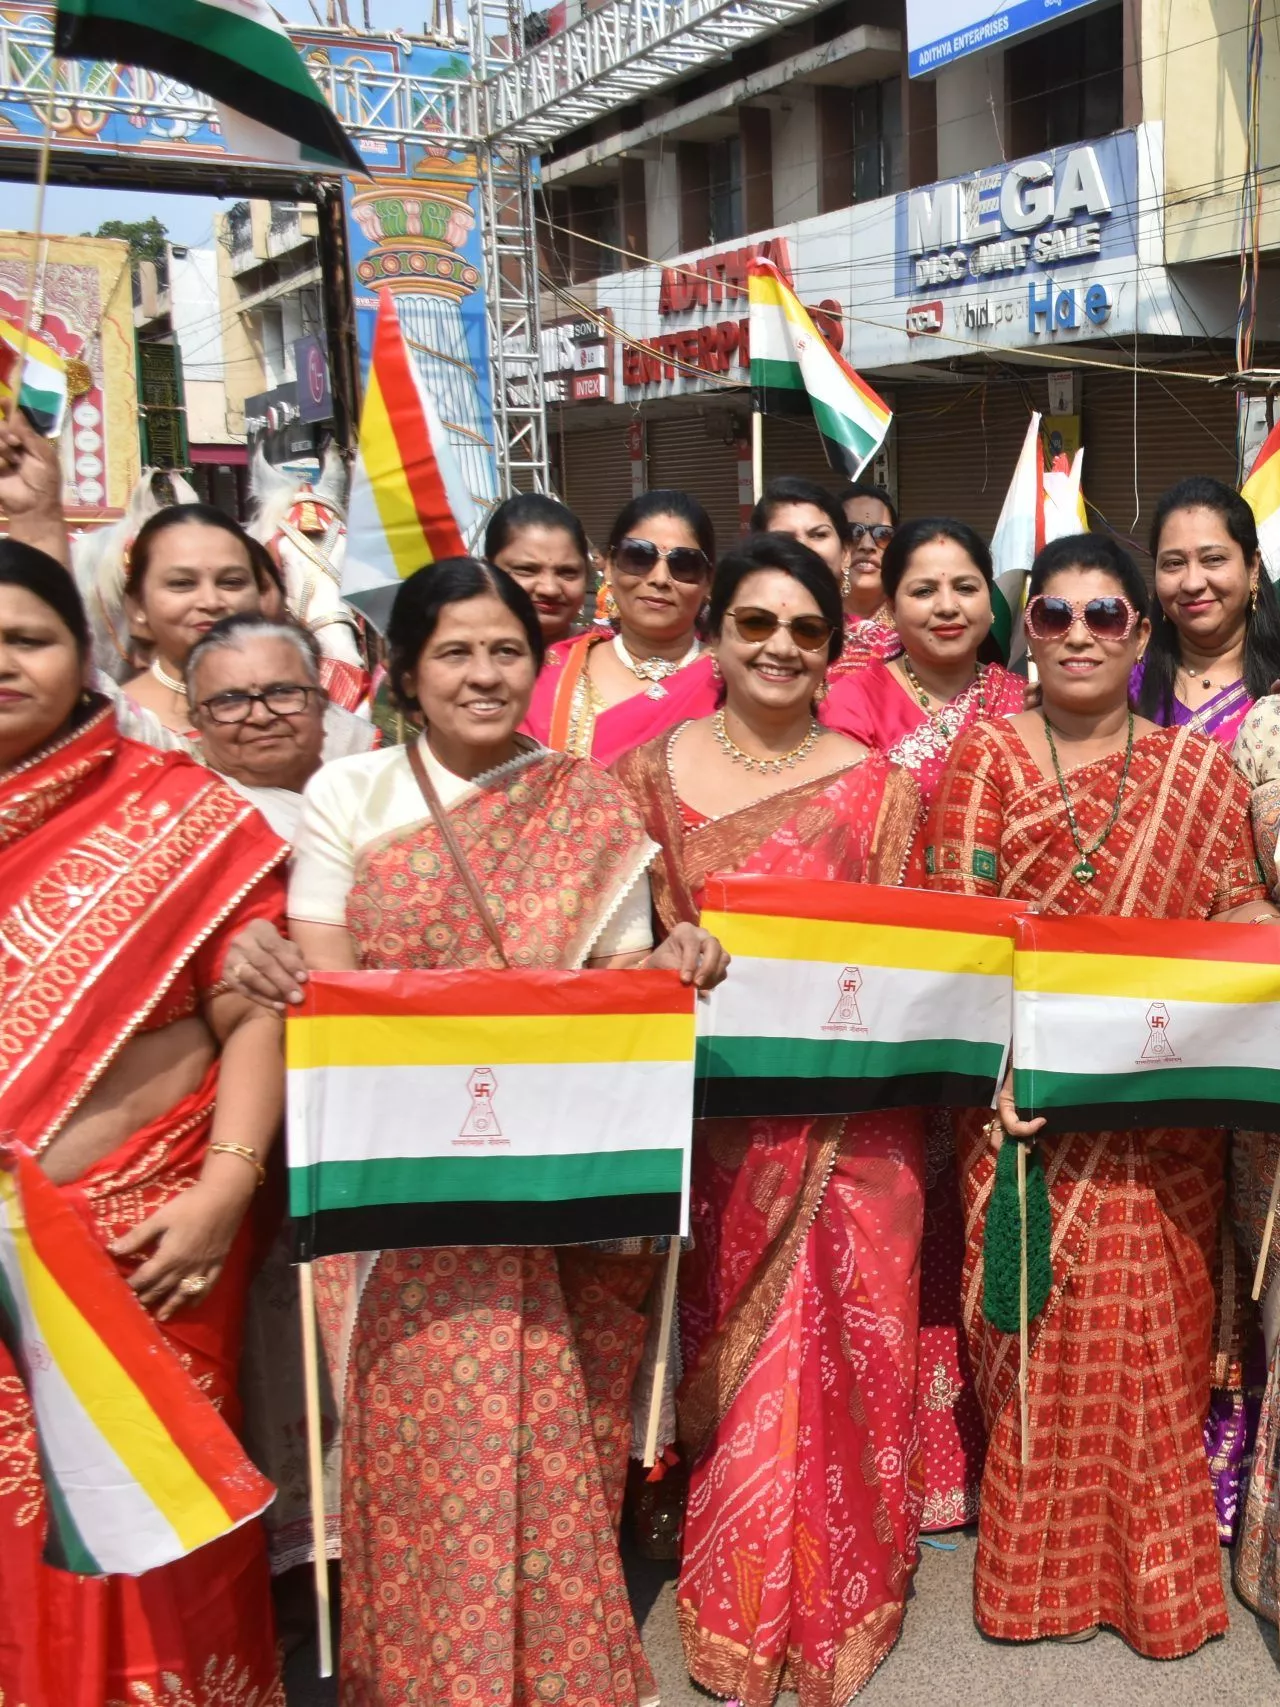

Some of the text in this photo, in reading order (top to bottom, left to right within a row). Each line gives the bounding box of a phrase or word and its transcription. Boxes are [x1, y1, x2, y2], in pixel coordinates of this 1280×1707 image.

[918, 15, 1009, 67] ADITHYA ENTERPRISES
[908, 146, 1113, 256] MEGA
[1033, 222, 1101, 265] SALE
[658, 237, 795, 316] ADITHA
[574, 322, 598, 337] SONY
[907, 308, 942, 332] TCL
